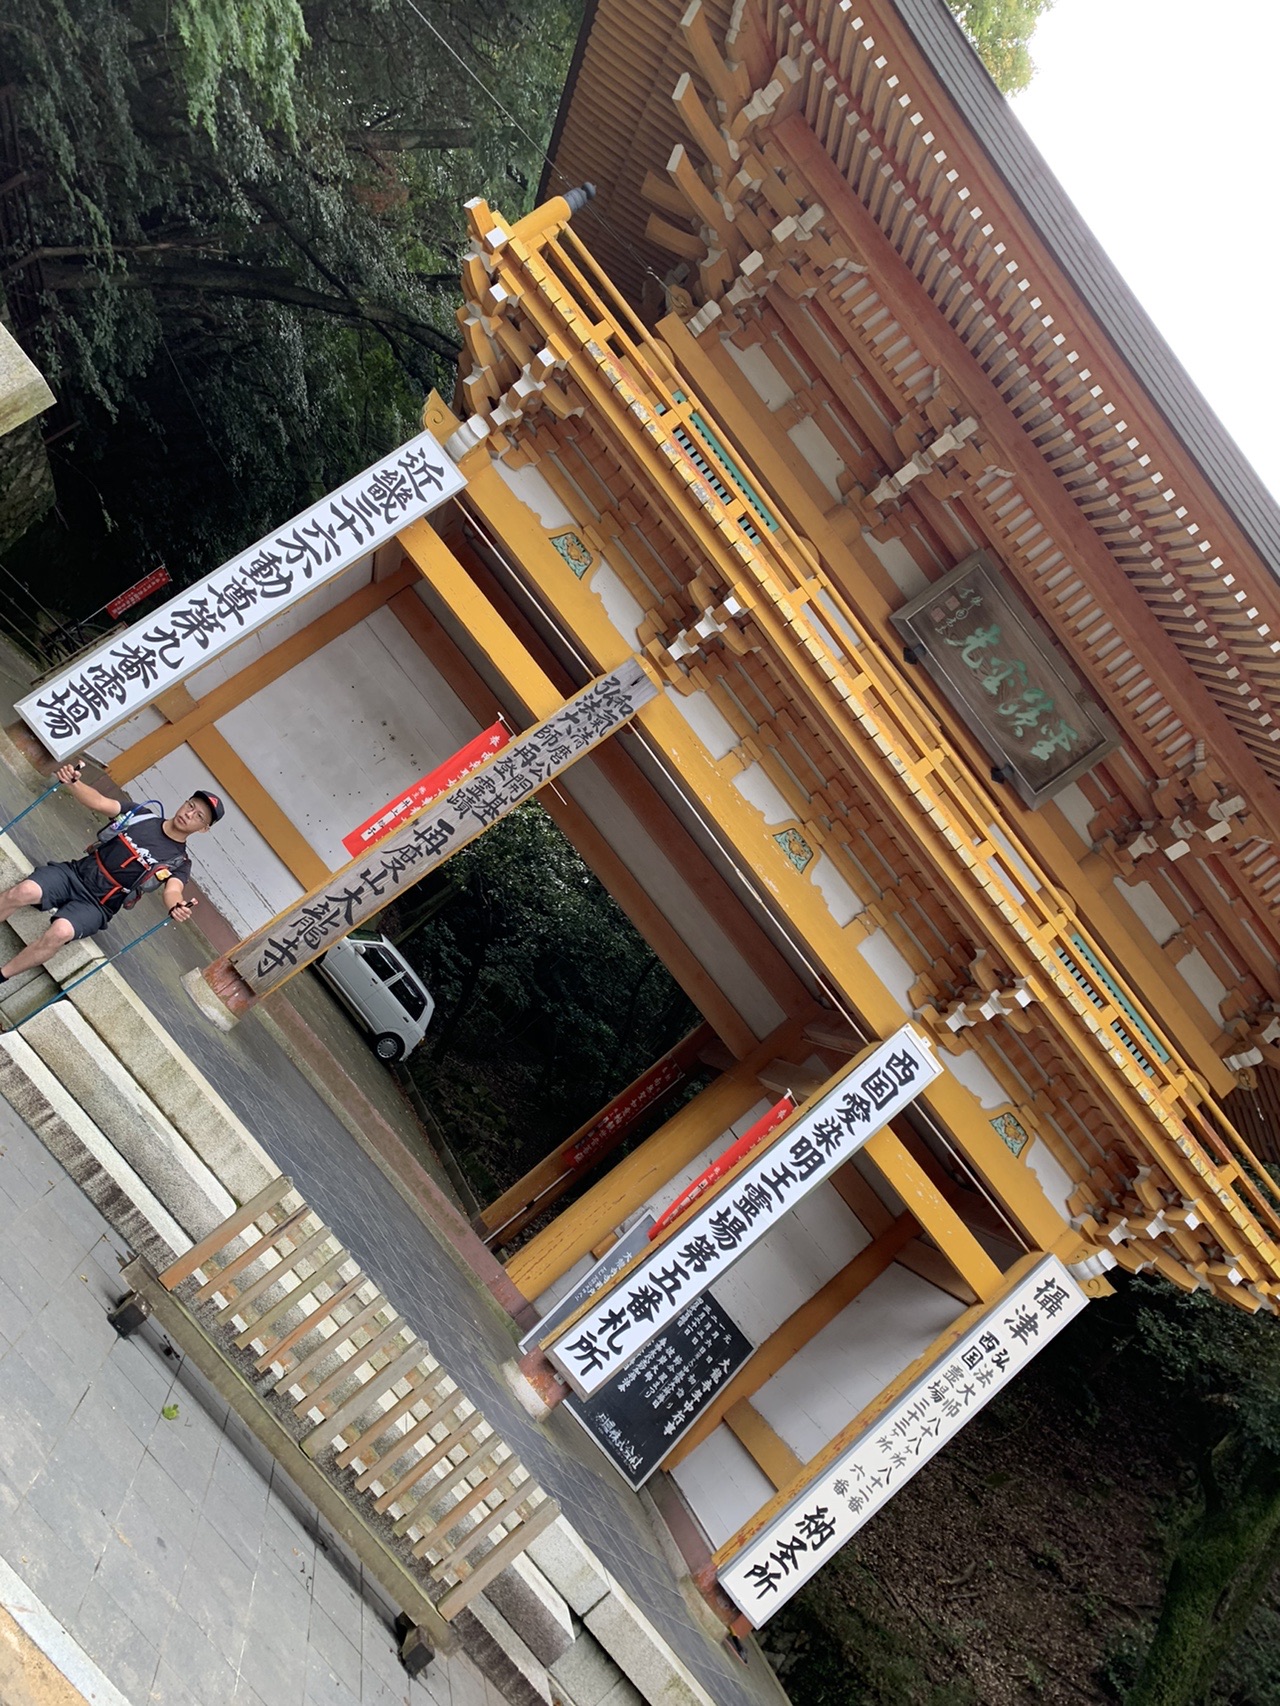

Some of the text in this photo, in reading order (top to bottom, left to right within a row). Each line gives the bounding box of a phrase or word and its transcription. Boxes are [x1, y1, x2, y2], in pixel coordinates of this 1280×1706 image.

[37, 448, 444, 739] 近畿三十六不動尊第九番霊場
[252, 819, 455, 990] 再度山大龍寺
[565, 1049, 919, 1376] 西国愛染明王霊場第五番札所
